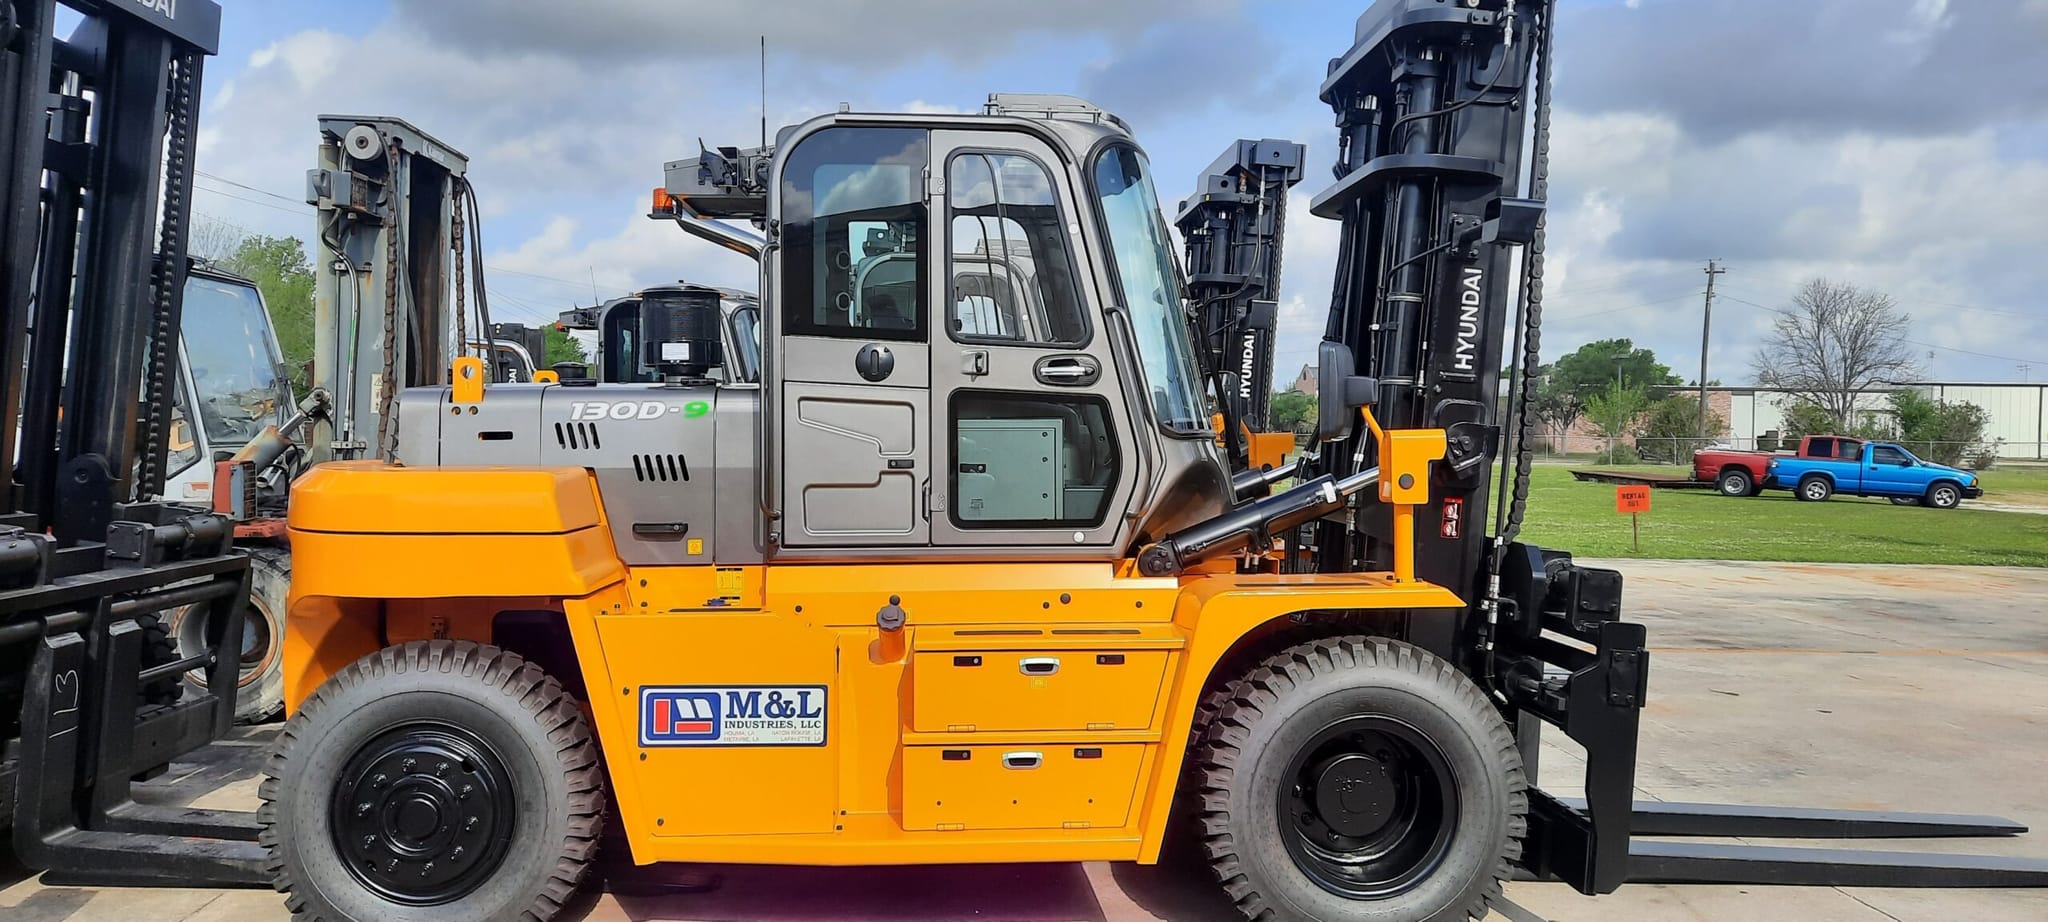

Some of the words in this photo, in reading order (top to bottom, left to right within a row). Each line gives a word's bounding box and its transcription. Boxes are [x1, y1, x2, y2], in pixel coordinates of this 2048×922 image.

[1454, 268, 1483, 370] HYUNDAI
[1240, 335, 1255, 398] HYUNDAI
[570, 400, 709, 421] 130D-9
[726, 691, 822, 718] M&L
[724, 720, 797, 729] INDUSTRIES,
[800, 720, 822, 729] LLC
